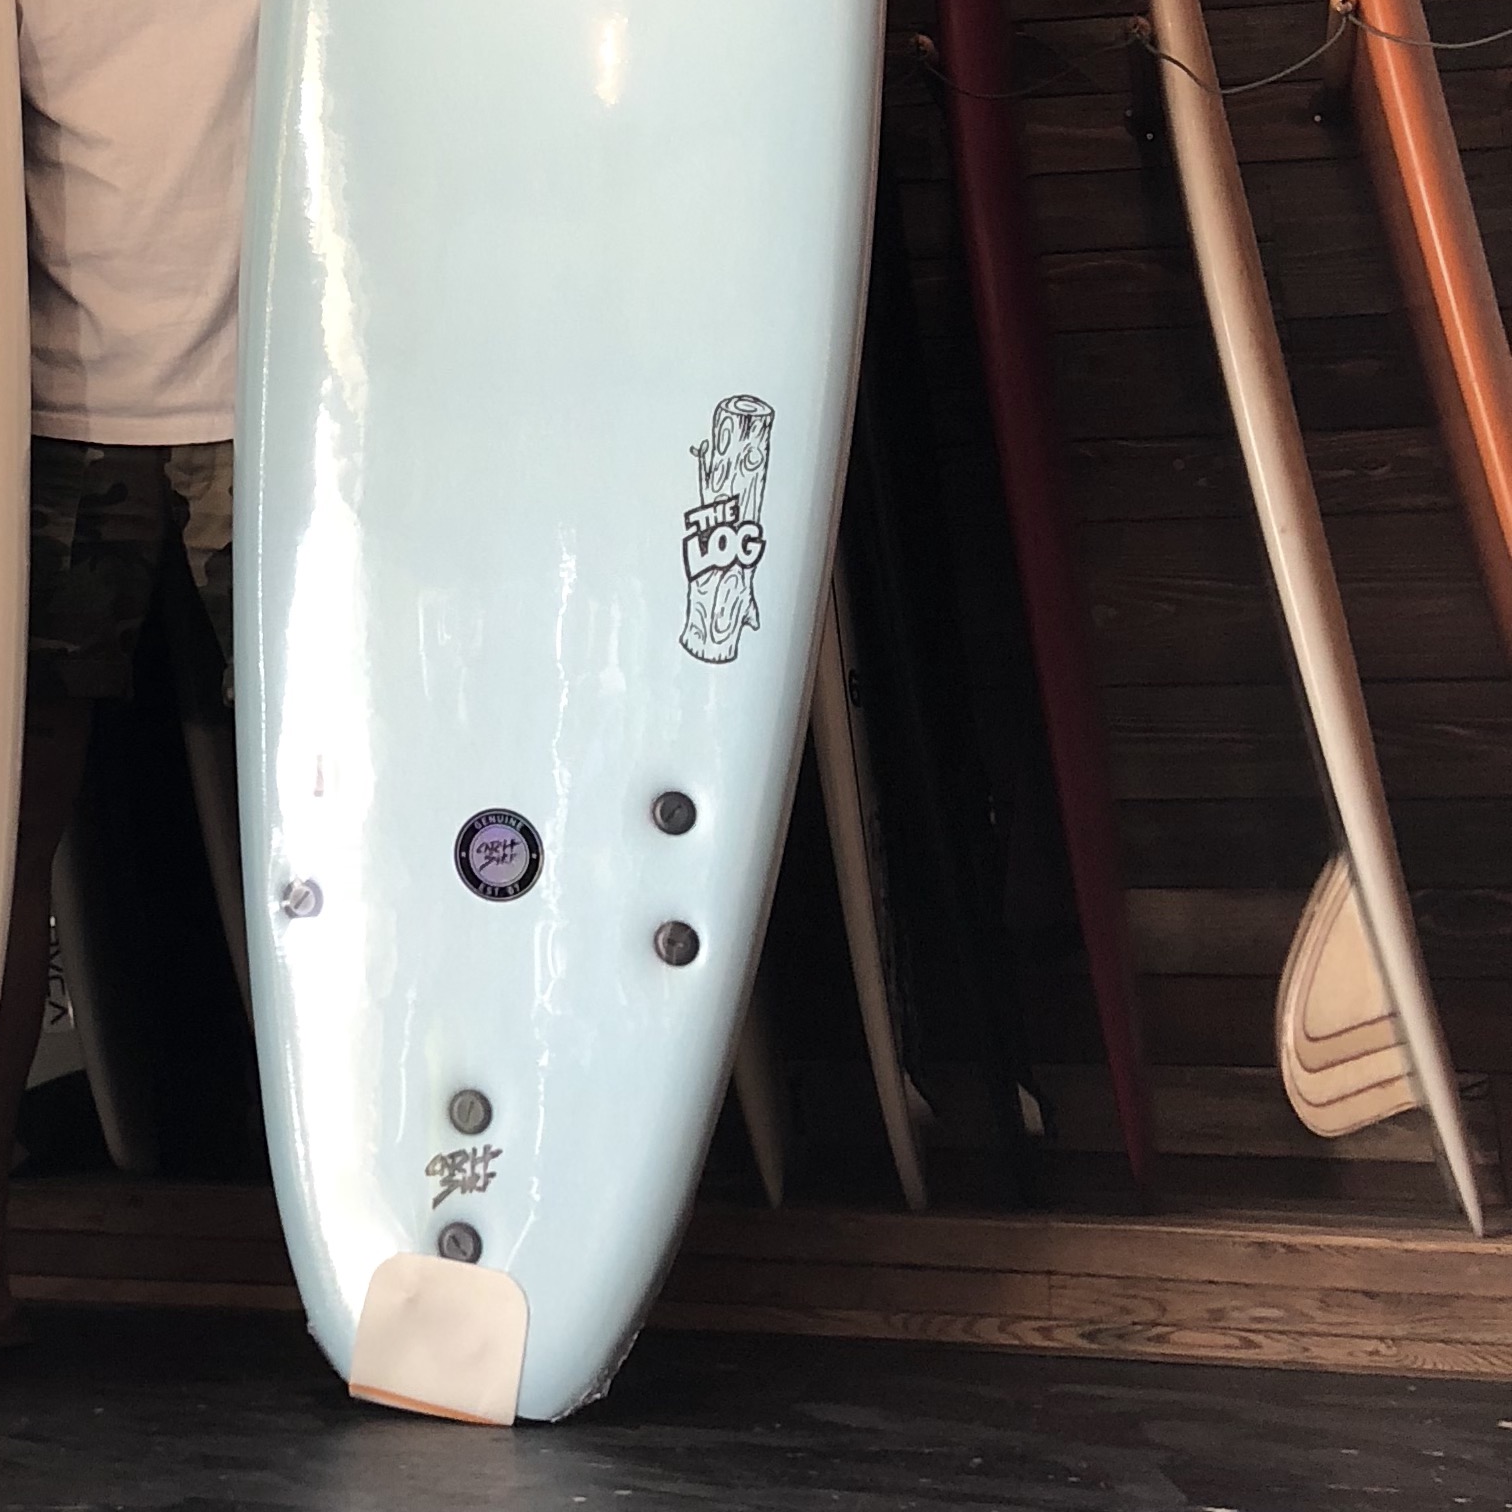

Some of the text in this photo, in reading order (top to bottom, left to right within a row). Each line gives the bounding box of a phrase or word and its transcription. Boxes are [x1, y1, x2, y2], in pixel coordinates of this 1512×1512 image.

[687, 500, 738, 533] THE
[685, 524, 765, 580] LOG
[474, 815, 524, 831] GENUINE
